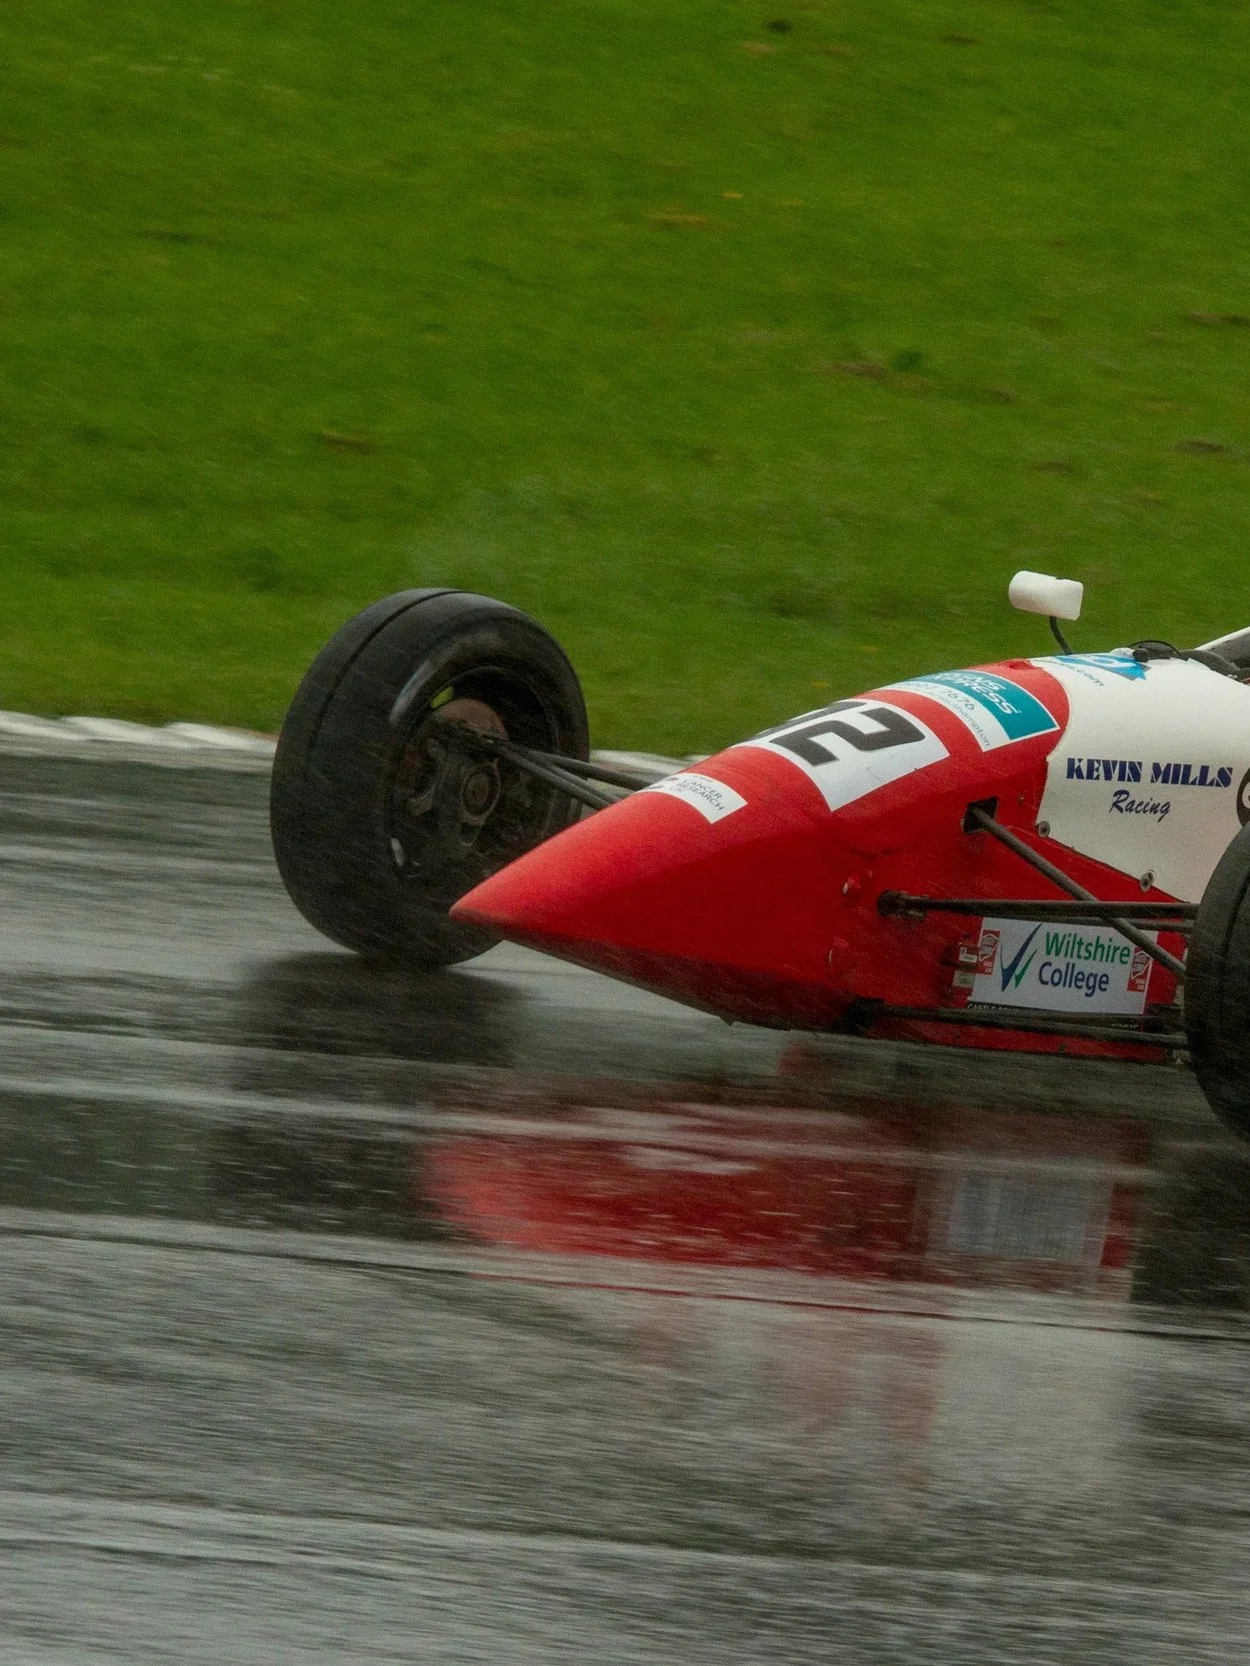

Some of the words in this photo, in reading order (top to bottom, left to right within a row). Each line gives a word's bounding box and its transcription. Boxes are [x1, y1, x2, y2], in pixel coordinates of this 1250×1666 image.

[1066, 757, 1143, 783] KEVIN
[1150, 761, 1233, 788] MILLS
[1109, 789, 1172, 823] Racing
[1045, 931, 1131, 966] Wiltshire
[1038, 961, 1110, 998] College
